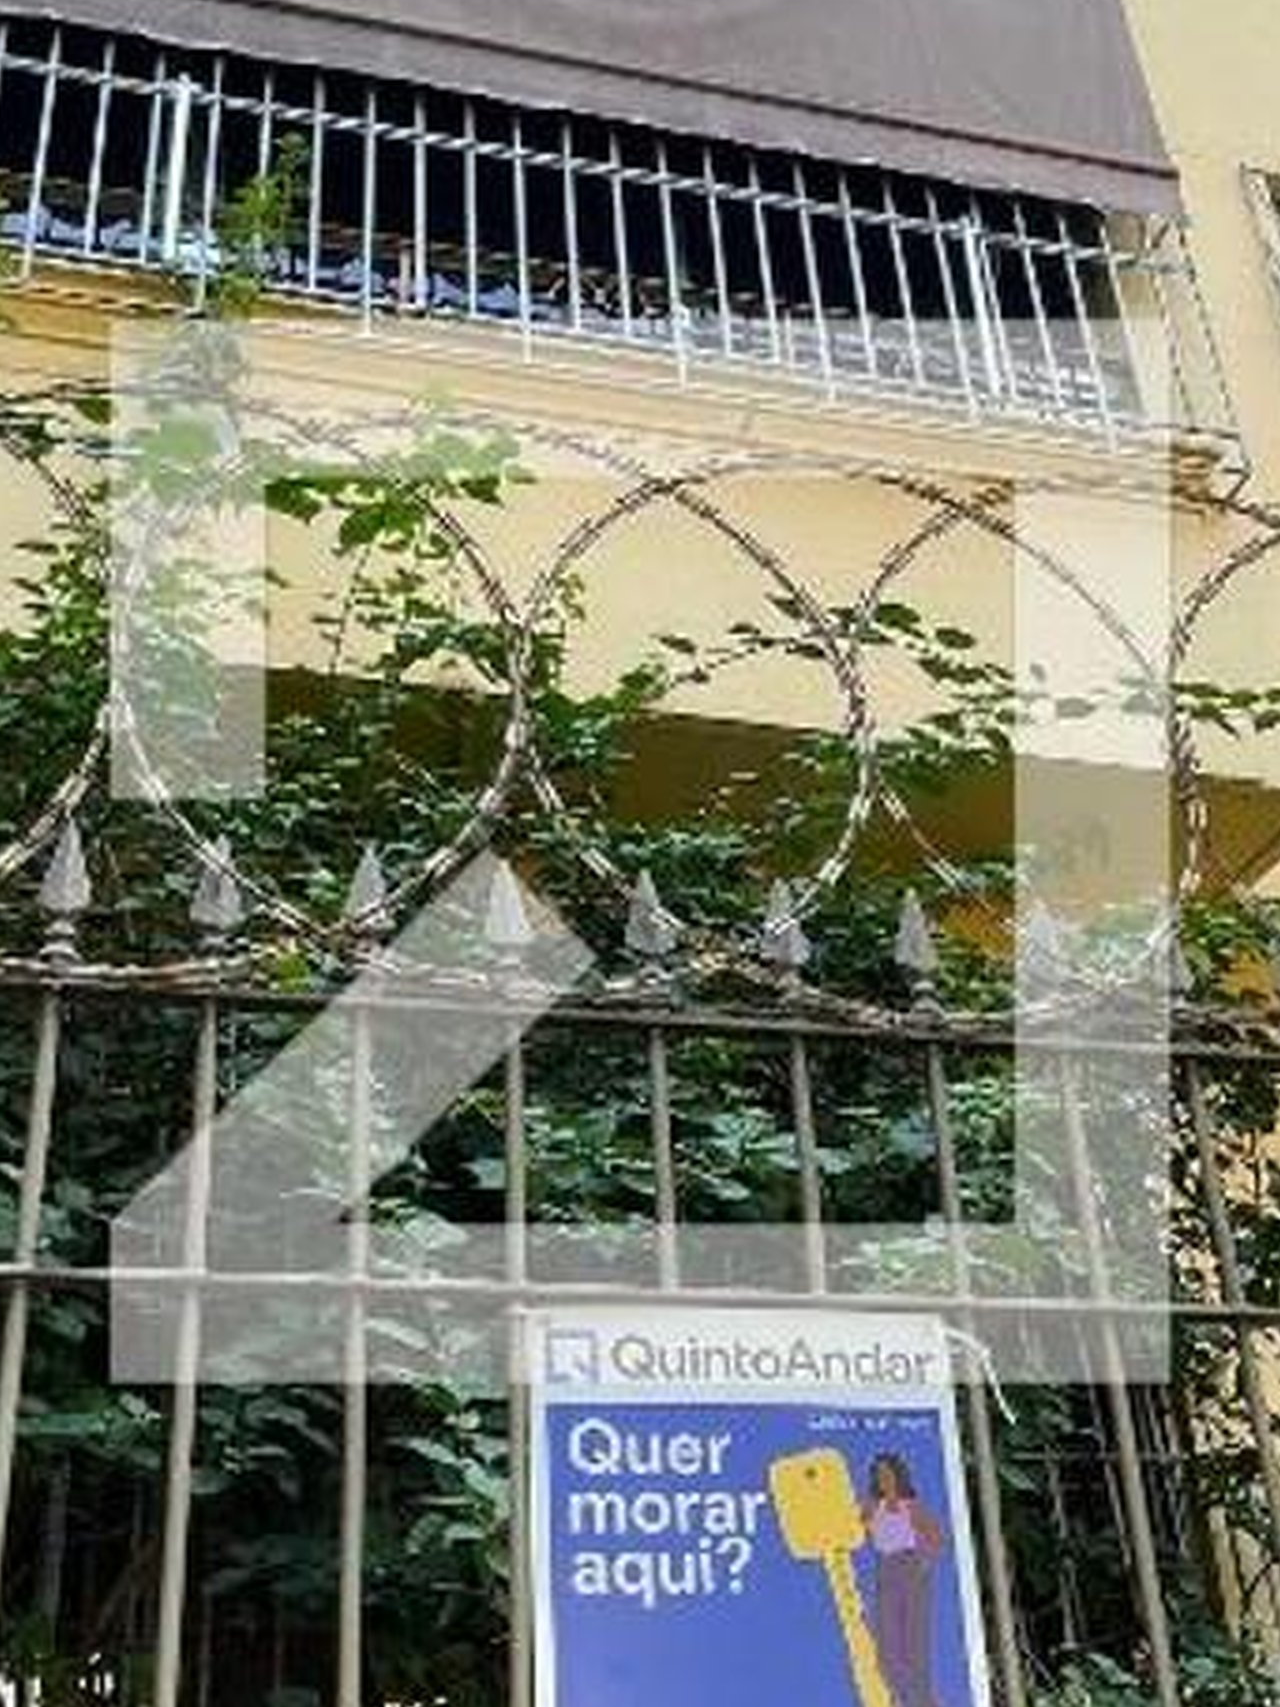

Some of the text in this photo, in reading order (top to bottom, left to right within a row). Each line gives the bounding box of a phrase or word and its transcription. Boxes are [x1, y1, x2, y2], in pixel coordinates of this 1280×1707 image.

[611, 1336, 933, 1384] QuintoAndar
[570, 1419, 730, 1475] Quer
[570, 1490, 765, 1533] morar
[574, 1539, 751, 1606] aqui?
